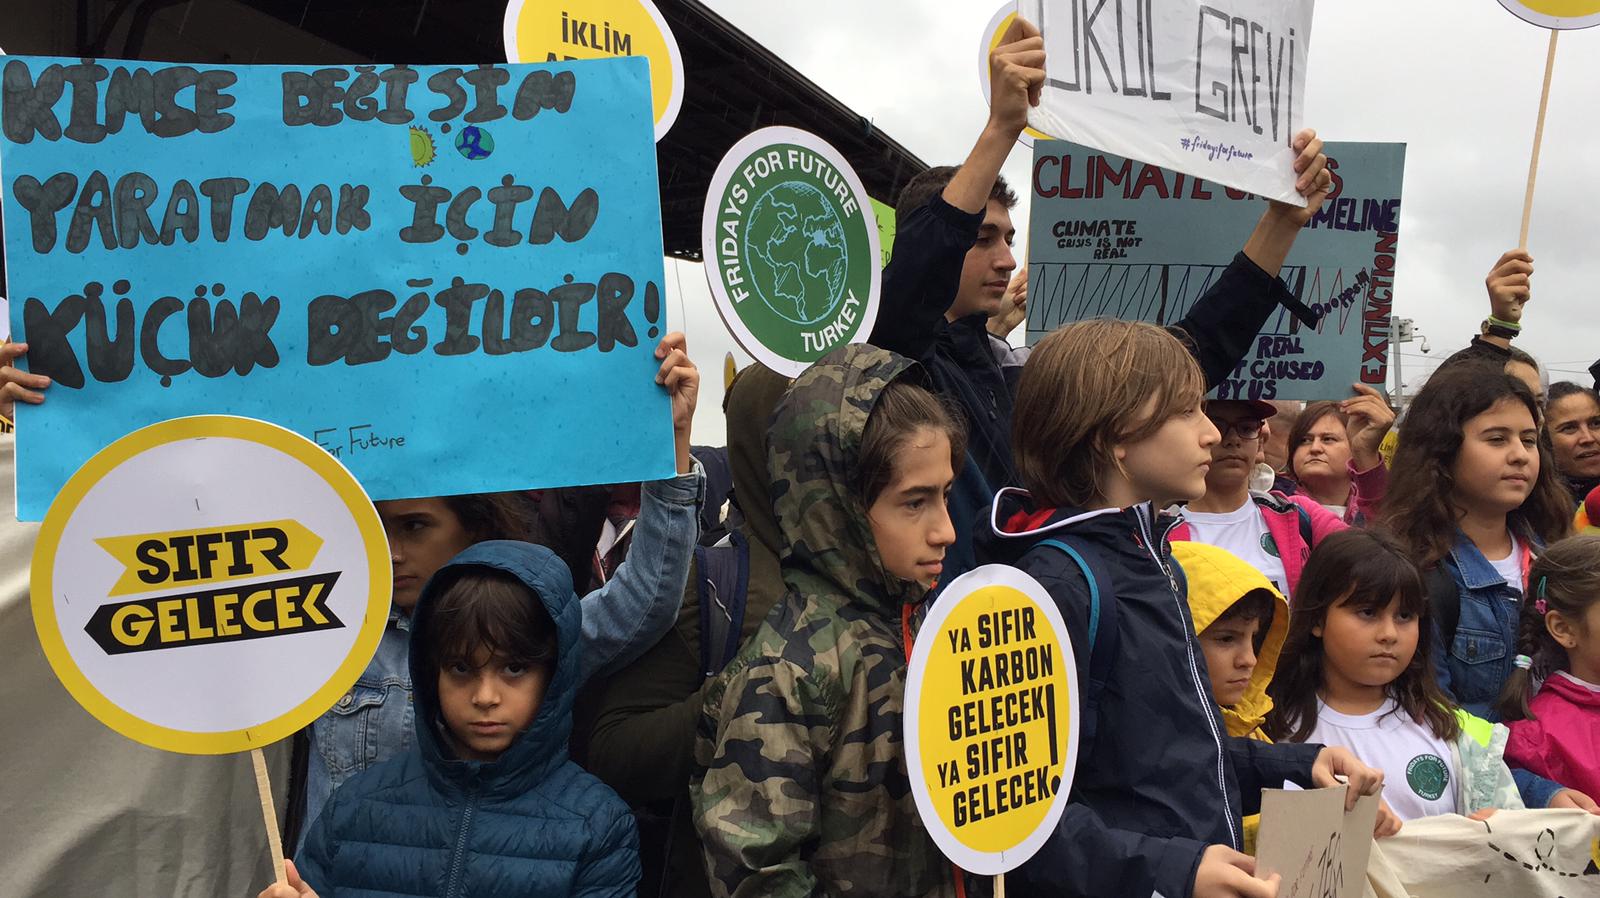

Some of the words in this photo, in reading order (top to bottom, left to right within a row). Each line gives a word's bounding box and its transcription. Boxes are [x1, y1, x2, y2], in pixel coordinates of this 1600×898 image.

[562, 11, 631, 56] İKLİM
[13, 170, 371, 254] YARATMAK
[399, 174, 599, 255] İÇİN
[722, 183, 750, 303] FRIDAYS
[743, 151, 784, 188] FOR
[787, 150, 858, 218] FUTURE
[1052, 220, 1137, 238] CLIMATE
[1057, 238, 1092, 249] CRISIS
[1097, 237, 1111, 248] IS
[1116, 236, 1143, 248] NOT
[1093, 248, 1128, 260] REAL
[23, 279, 281, 389] KÜÇÜK
[307, 272, 660, 366] DEĞİLDİR!
[800, 289, 860, 352] TURKEY
[1360, 230, 1399, 384] EXTINCTION
[1250, 360, 1325, 381] CAUSED
[1257, 336, 1304, 359] REAL
[1217, 379, 1247, 400] BY
[1248, 379, 1277, 400] US
[349, 424, 405, 454] Future
[136, 527, 291, 584] SIFIR
[110, 583, 330, 646] GELECEK
[948, 628, 972, 654] YA
[978, 607, 1036, 649] SIFIR
[961, 644, 1054, 696] KARBON
[937, 760, 961, 789] YA
[966, 732, 1028, 781] SIFIR
[1418, 789, 1438, 799] TURKEY
